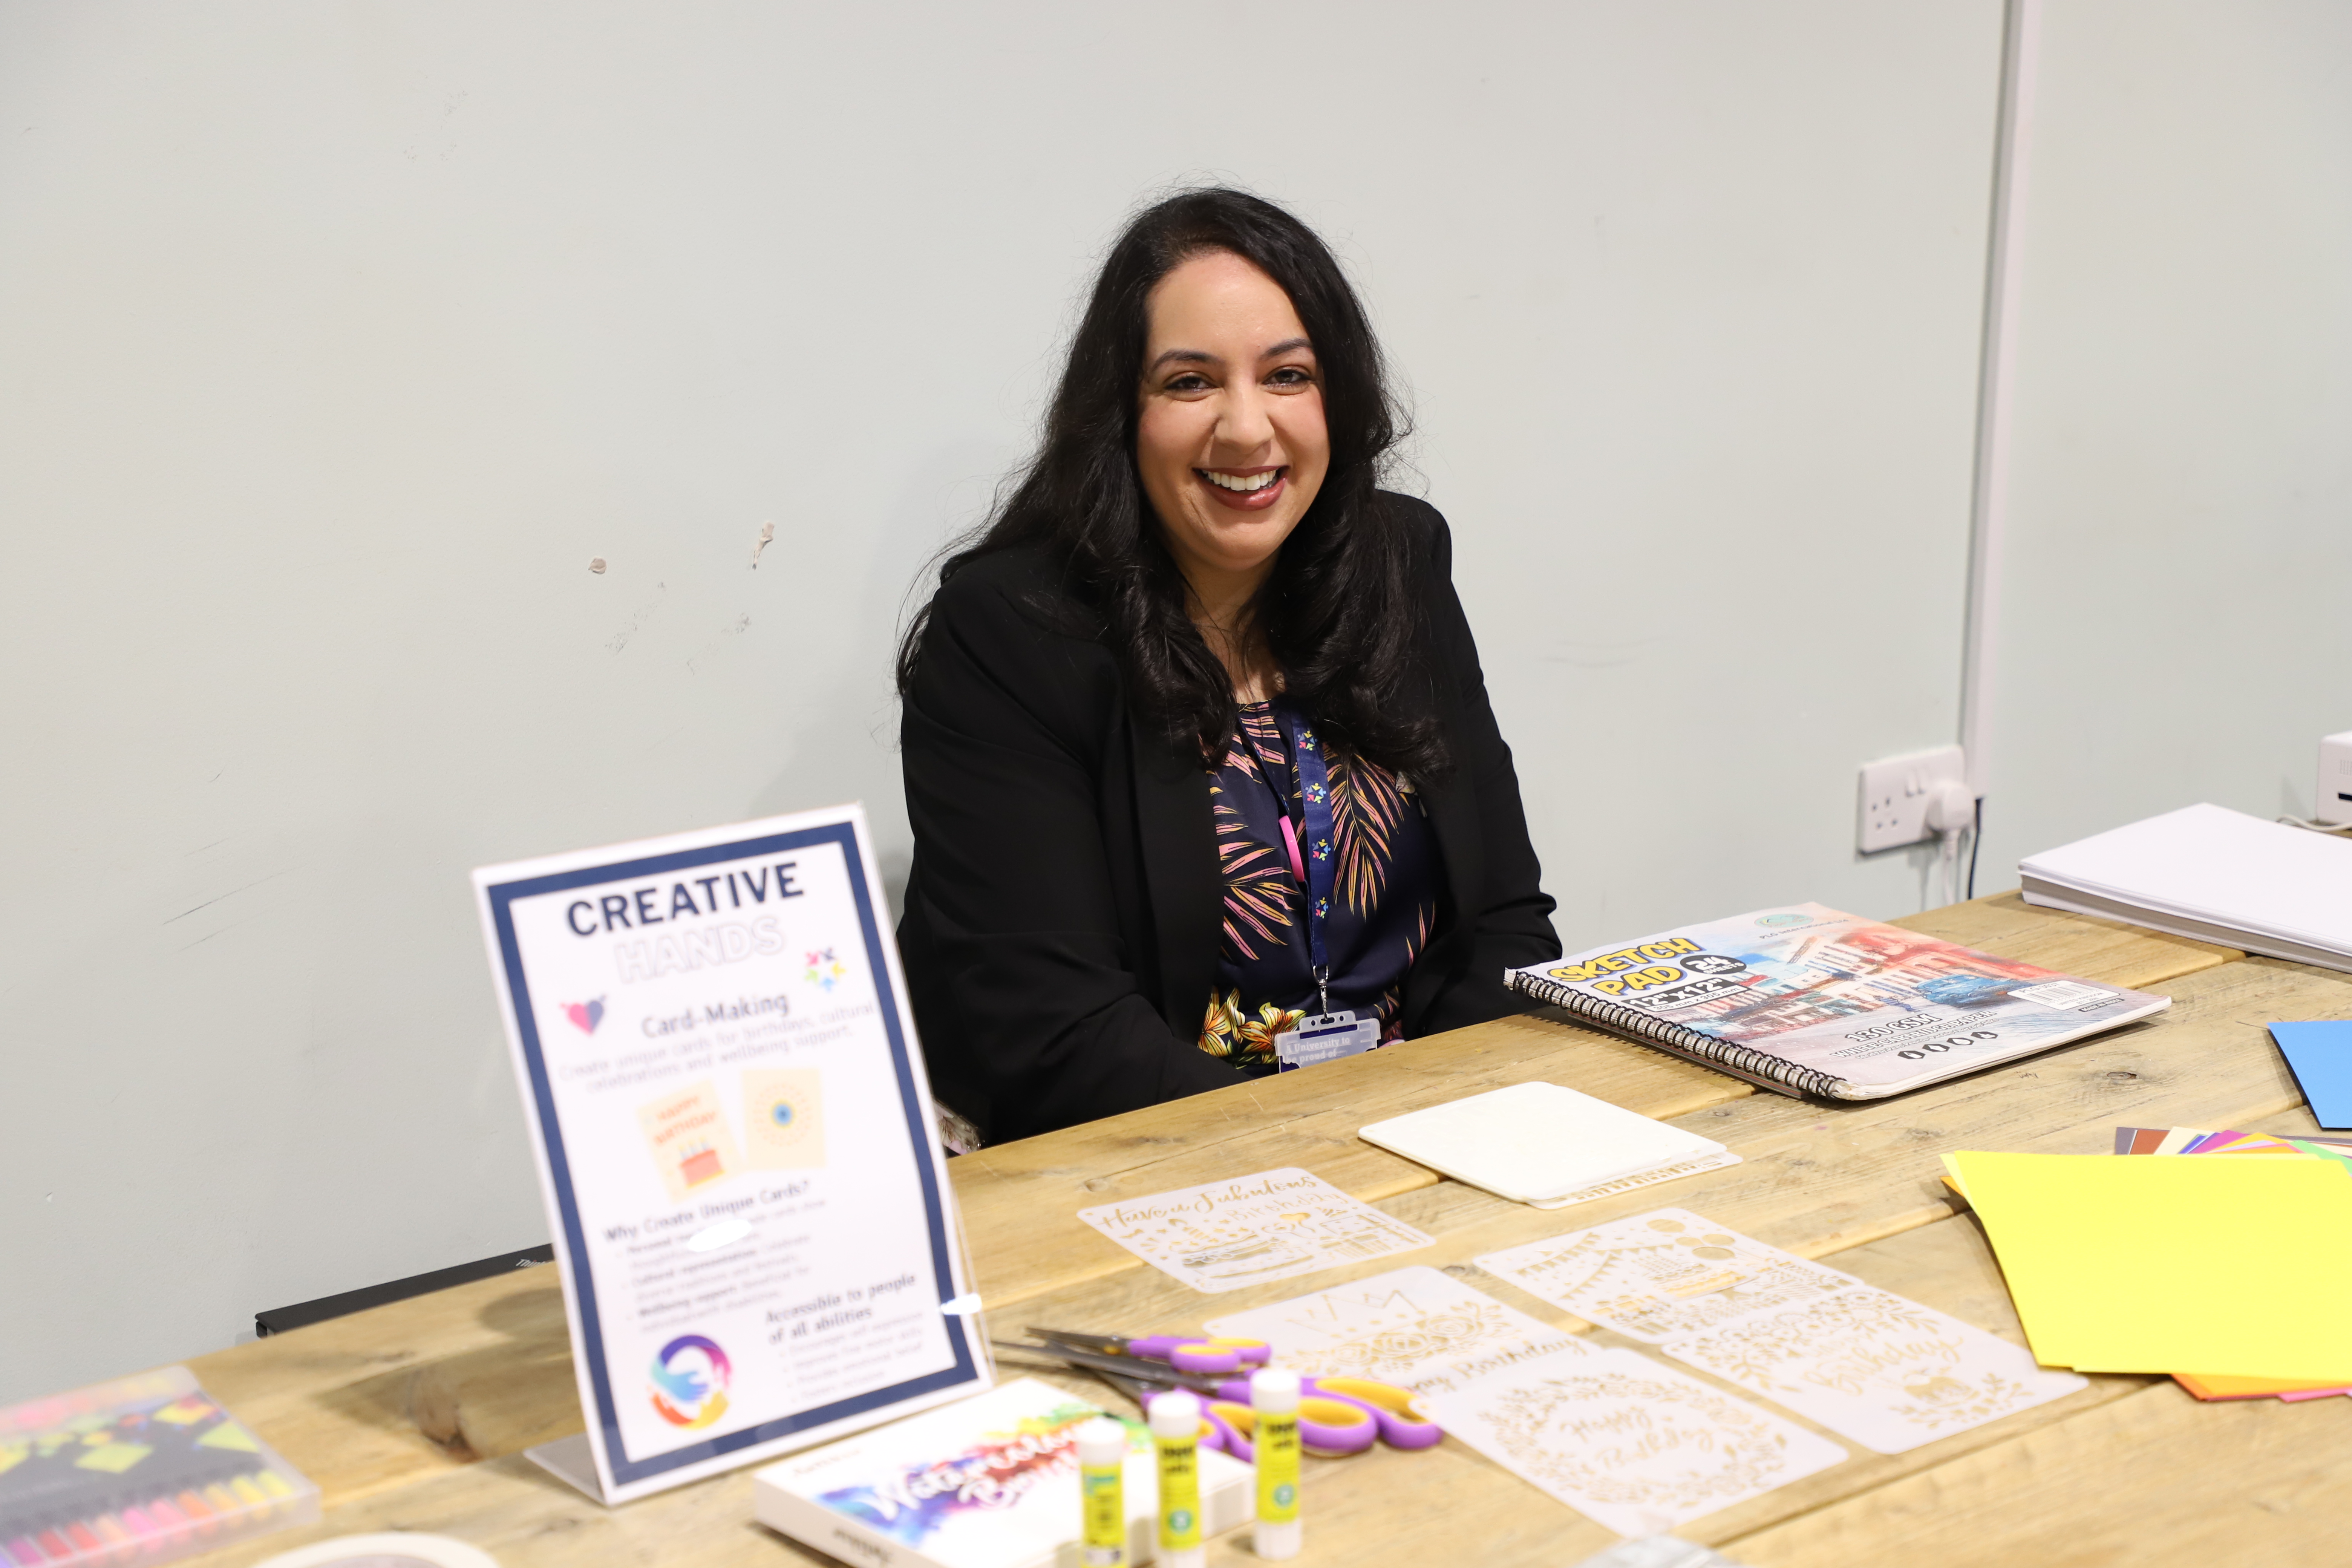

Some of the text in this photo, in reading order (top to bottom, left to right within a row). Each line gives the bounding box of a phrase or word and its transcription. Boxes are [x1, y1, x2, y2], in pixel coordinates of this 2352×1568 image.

[568, 862, 803, 936] CREATIVE
[614, 916, 786, 984] HANDS
[1547, 938, 1703, 982] SKETCH
[1686, 956, 1732, 971] 24
[1703, 962, 1744, 974] SHEETS
[1591, 966, 1685, 996] PAD
[641, 993, 789, 1038] Card-Making
[1830, 1010, 1997, 1058] WHITE CARTRIDGE PAPER
[1845, 1014, 1943, 1042] 130 GSM
[559, 1060, 609, 1081] Create
[615, 1047, 666, 1070] unique
[672, 1037, 711, 1057] cards
[717, 1032, 737, 1047] for
[819, 1003, 875, 1025] cultural
[1286, 1044, 1292, 1053] A
[1294, 1038, 1339, 1053] University
[1300, 1050, 1326, 1065] proud
[1328, 1048, 1337, 1057] of
[586, 1062, 679, 1094] celebrations
[686, 1054, 712, 1072] and
[720, 1037, 789, 1065] wellbeing
[656, 1096, 700, 1121] HAPPY
[604, 1225, 638, 1242] Why
[643, 1212, 694, 1233] Create
[699, 1196, 754, 1218] Unique
[759, 1180, 809, 1204] Cards?
[1096, 1207, 1167, 1230] Have
[1170, 1203, 1190, 1214] a
[1224, 1192, 1349, 1222] Birthday
[515, 1258, 545, 1268] Thin
[766, 1294, 841, 1324] Accessible
[847, 1288, 862, 1301] to
[868, 1274, 916, 1299] people
[769, 1307, 872, 1345] of all abilities
[1449, 1338, 1588, 1380] Birthday
[1798, 1337, 1964, 1396] Birthday
[1559, 1406, 1653, 1444] Happy
[1595, 1427, 1714, 1470] Birthday
